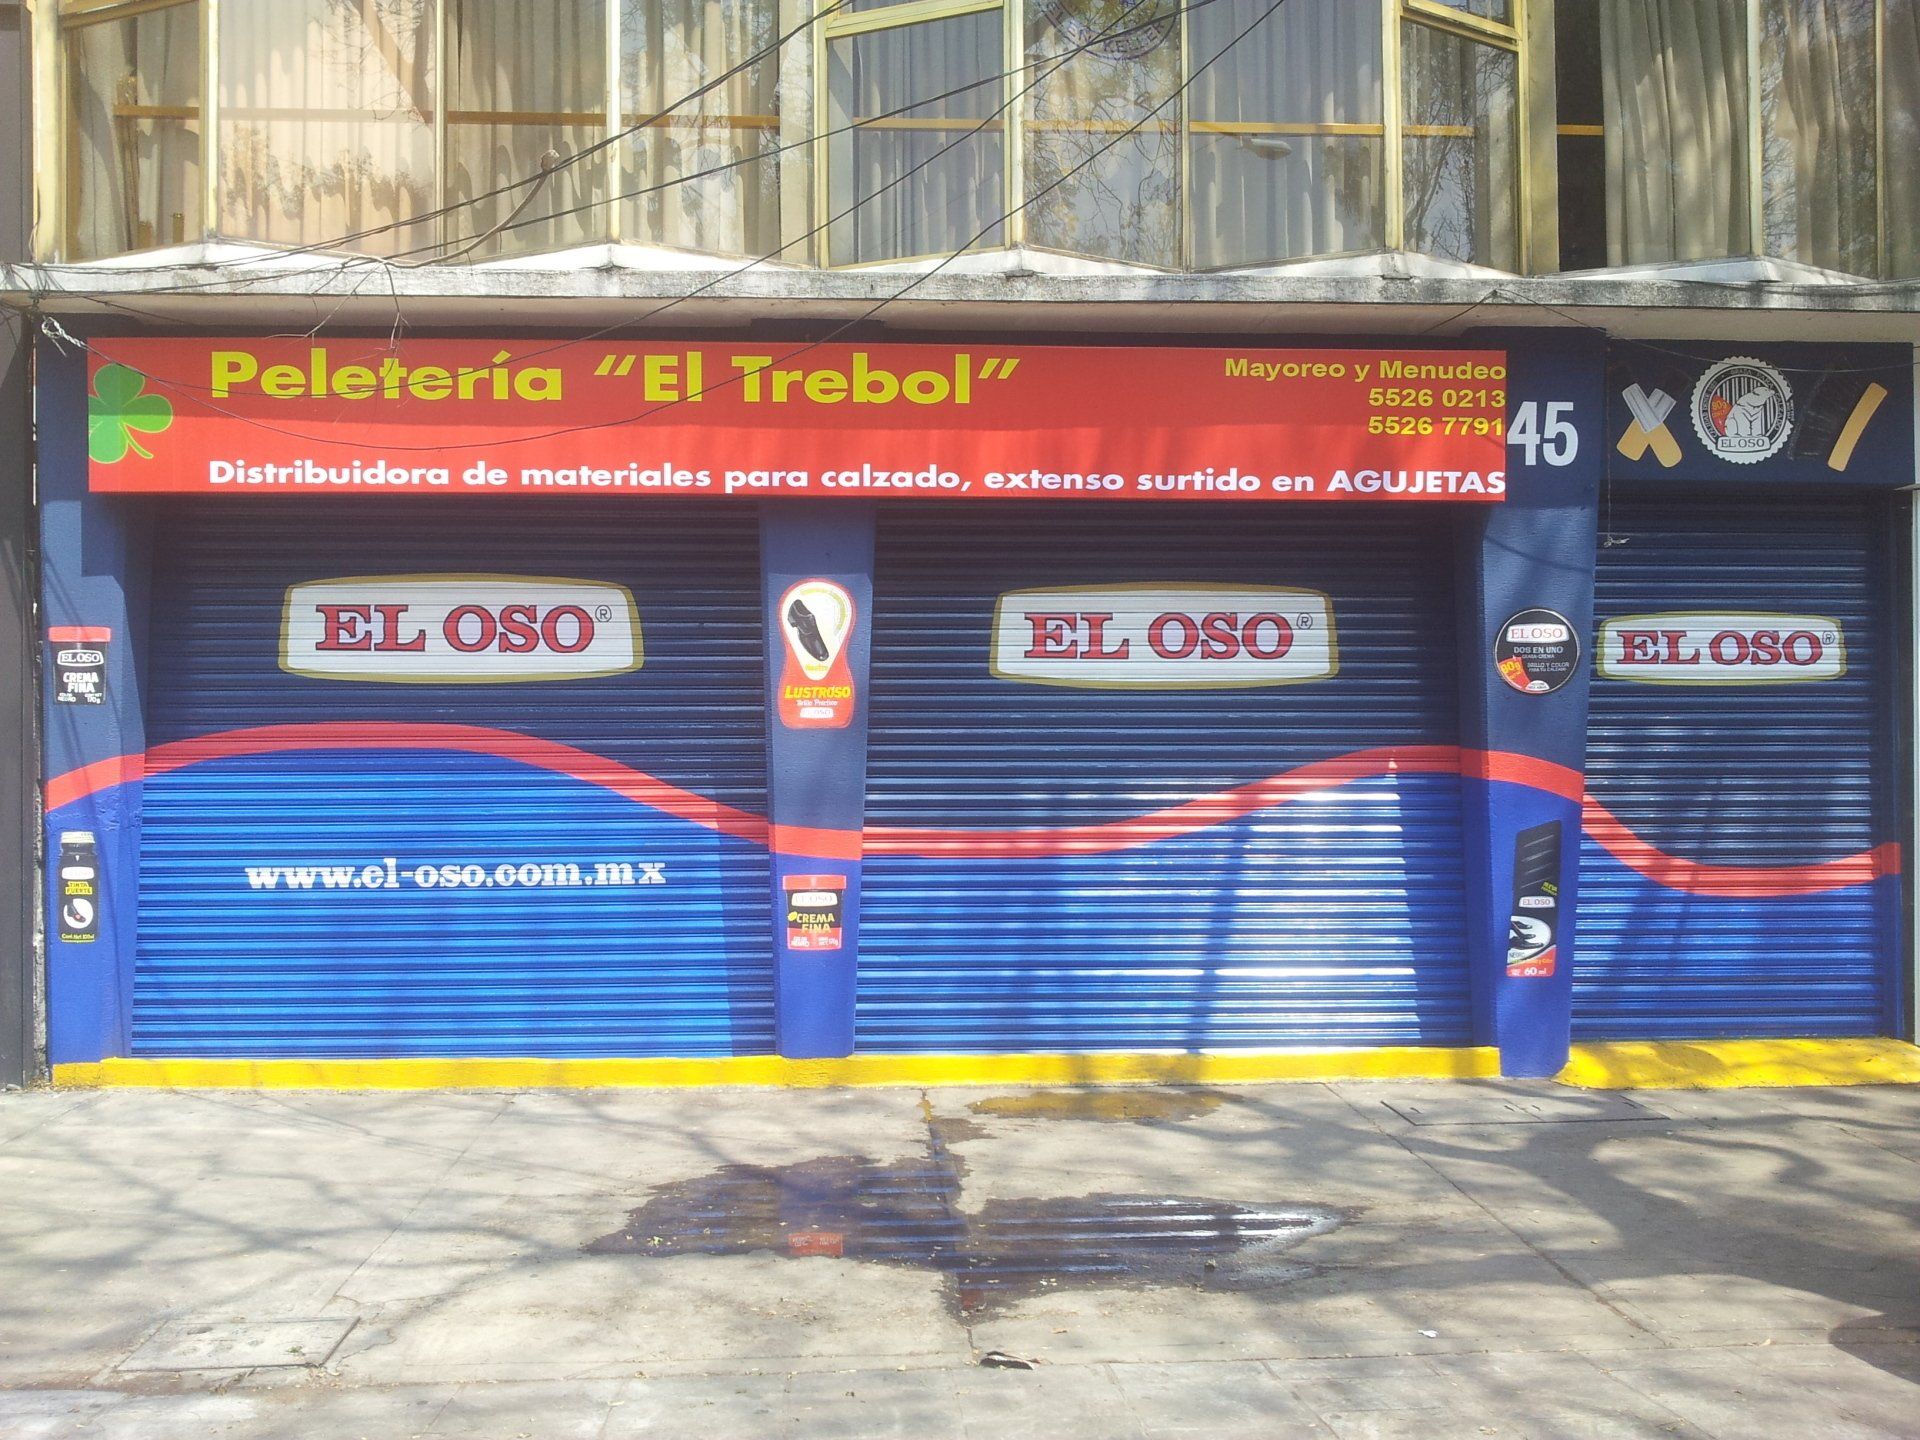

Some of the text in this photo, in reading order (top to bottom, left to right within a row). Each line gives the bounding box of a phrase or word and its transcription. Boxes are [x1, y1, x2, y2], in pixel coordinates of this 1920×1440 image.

[211, 347, 562, 400] Peletería
[1225, 358, 1507, 382] Mayoreo y Menudeo
[1368, 388, 1506, 408] 5526 0213
[1368, 416, 1503, 436] 5526 7791
[1506, 401, 1579, 467] 45
[1721, 438, 1765, 448] EL OSO
[209, 460, 1506, 494] Distribuidora de materiales para calzado, extenso surtido en AGUJETAS
[316, 604, 427, 652] EL
[1023, 612, 1130, 660] EL
[1511, 627, 1563, 639] EL OSO
[61, 652, 100, 663] EL OSO
[1513, 646, 1564, 654] DOS EN UNO
[1616, 630, 1700, 665] EL
[63, 672, 99, 683] CREMA
[68, 682, 95, 693] FINA
[784, 685, 852, 699] LUSTROSO
[244, 857, 667, 889] www.el-oso.com.mx
[797, 913, 835, 923] CREMA
[801, 923, 831, 933] FINA
